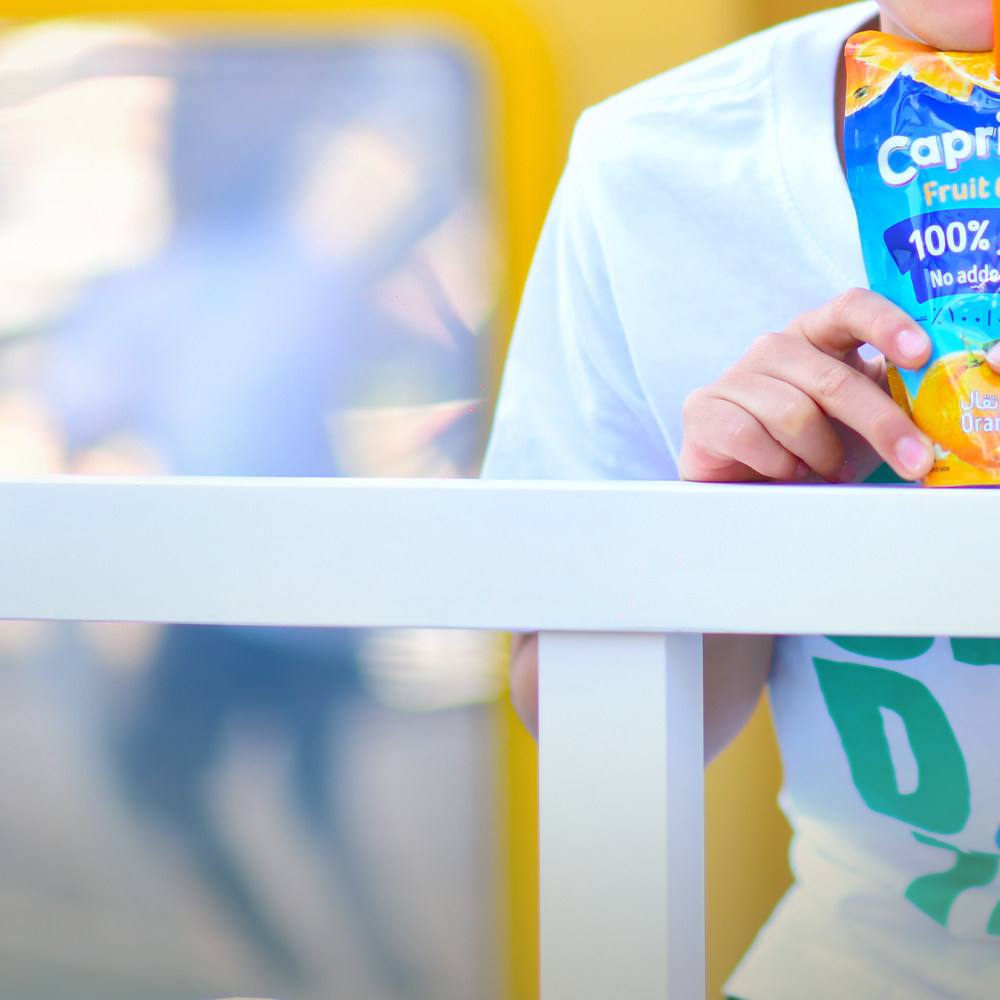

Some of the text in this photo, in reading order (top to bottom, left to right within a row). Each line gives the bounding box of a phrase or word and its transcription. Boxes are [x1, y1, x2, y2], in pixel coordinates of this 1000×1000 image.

[923, 177, 991, 207] Fruit
[908, 219, 991, 262] 100%
[929, 268, 954, 289] No
